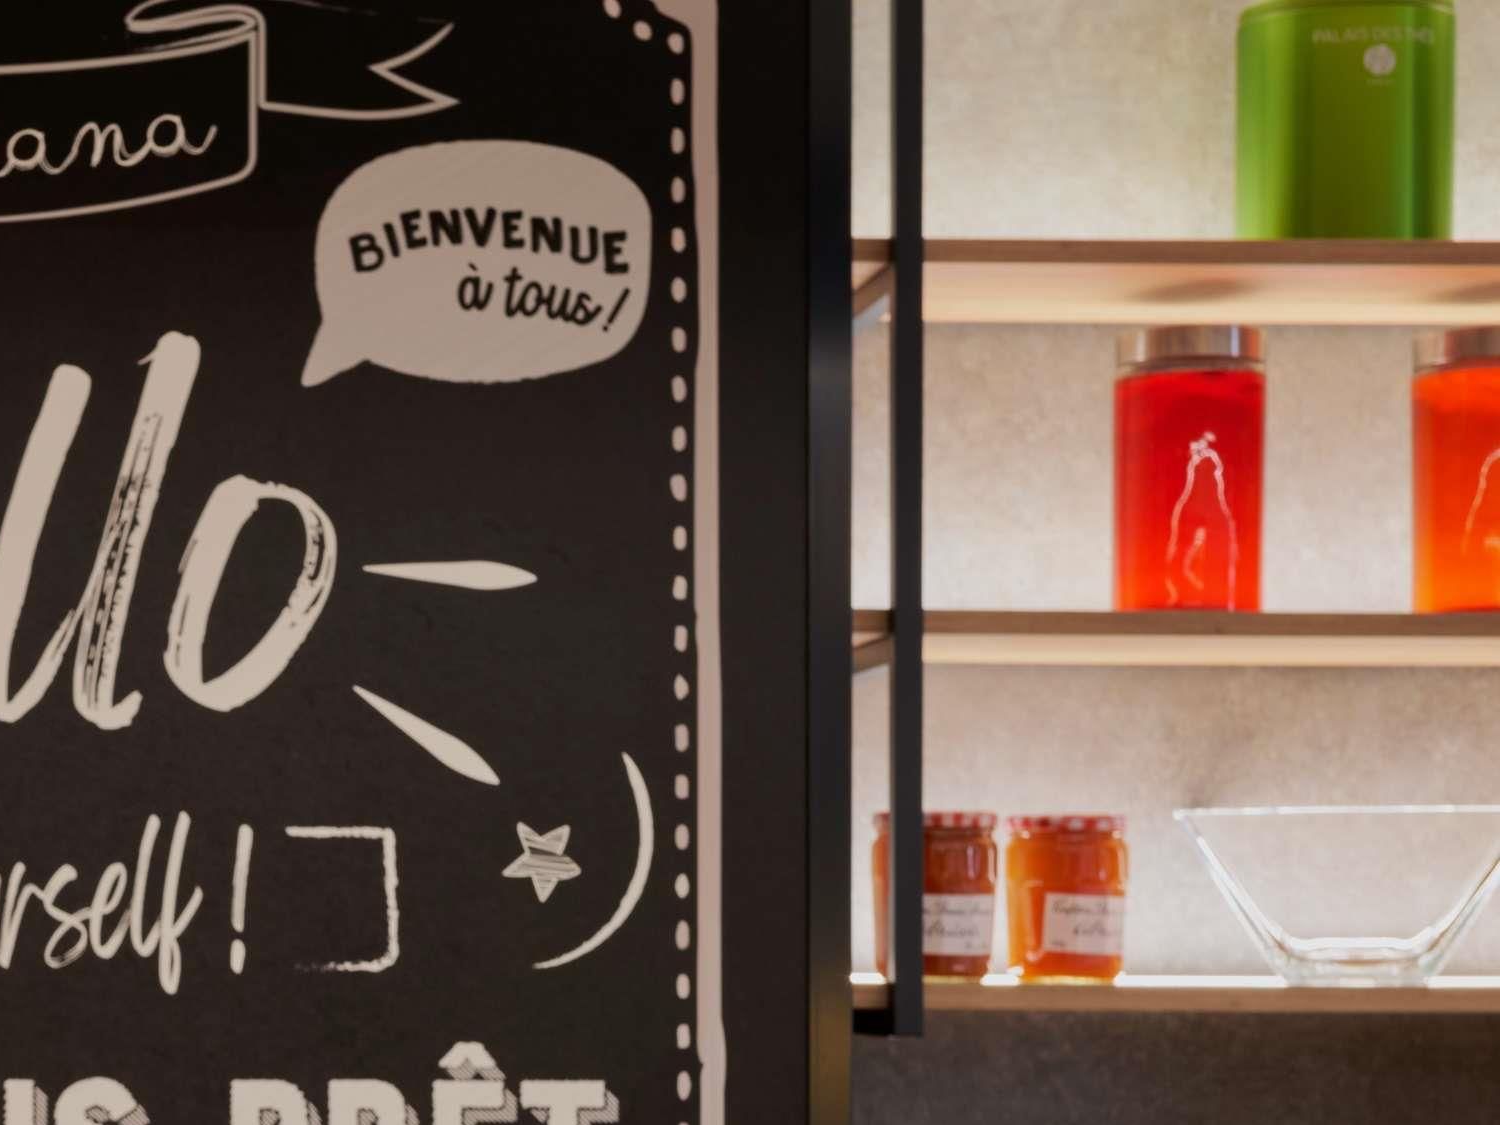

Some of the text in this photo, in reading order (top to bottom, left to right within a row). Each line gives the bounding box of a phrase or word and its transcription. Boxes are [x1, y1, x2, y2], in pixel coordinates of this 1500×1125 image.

[348, 206, 630, 274] BIENVENUE
[457, 262, 631, 333] à tous!
